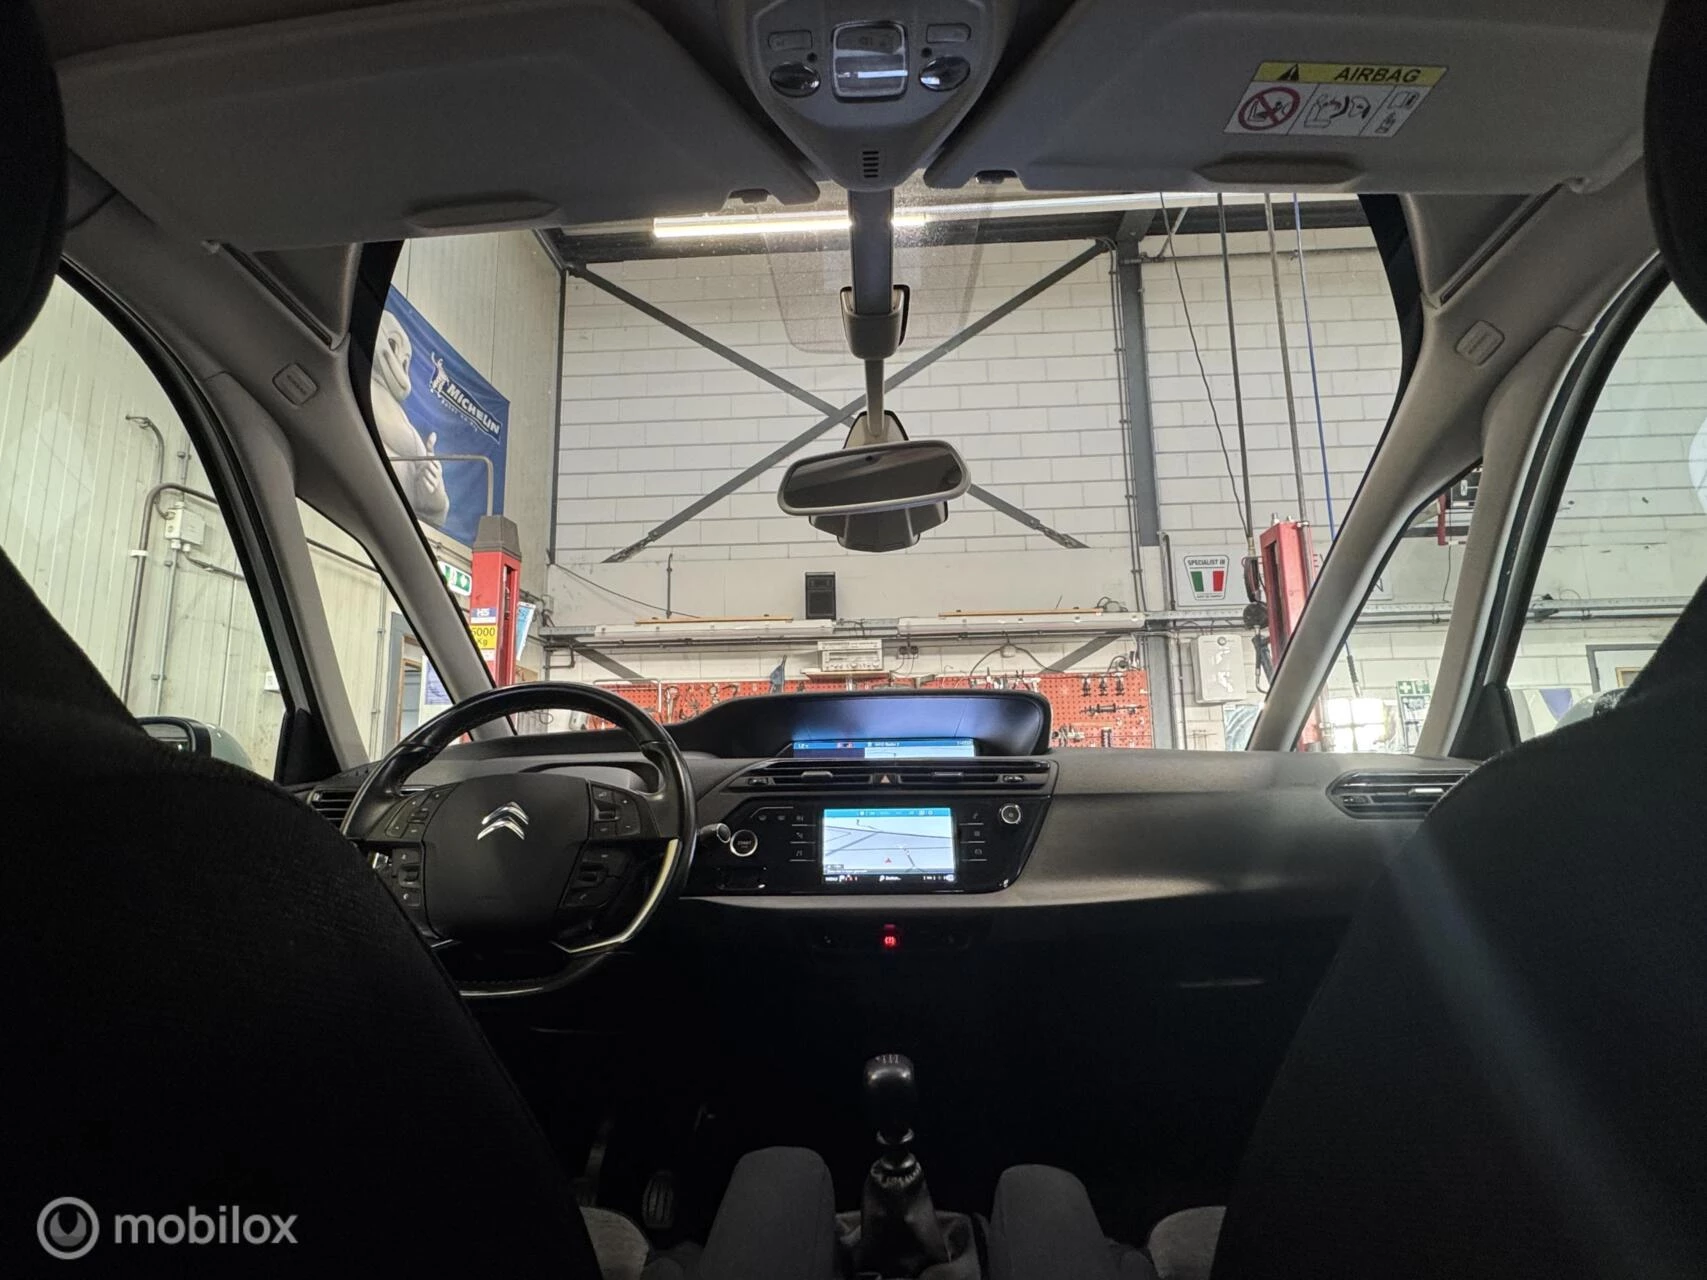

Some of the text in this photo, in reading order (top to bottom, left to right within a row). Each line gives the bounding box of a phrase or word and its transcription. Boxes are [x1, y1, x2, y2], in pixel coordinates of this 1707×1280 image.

[1334, 67, 1422, 83] AIRBAG
[446, 383, 501, 434] MICHELIN
[472, 627, 496, 636] 5000
